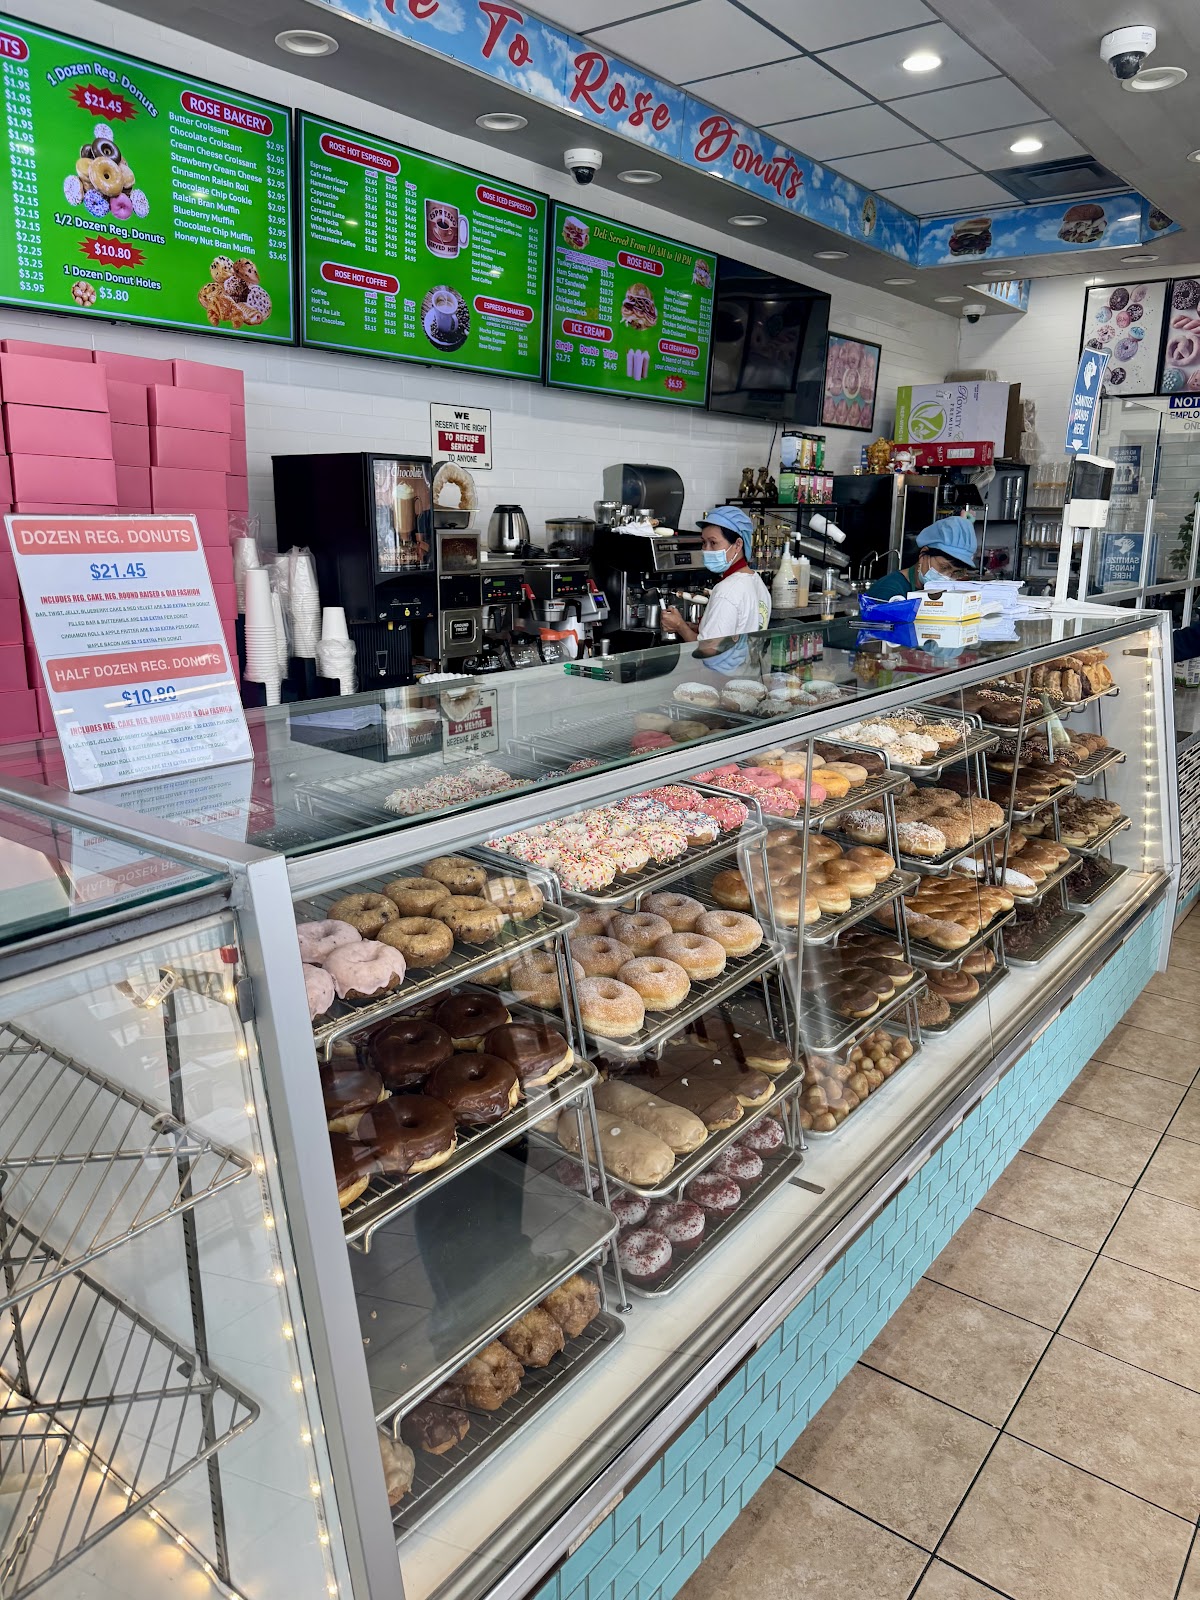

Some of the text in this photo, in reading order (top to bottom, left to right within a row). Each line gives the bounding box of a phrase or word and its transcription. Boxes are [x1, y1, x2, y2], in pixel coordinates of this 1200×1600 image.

[0, 37, 21, 56] TS
[3, 62, 28, 78] $1.95
[4, 75, 30, 91] $1.95
[47, 63, 158, 118] 1 Dozen Reg. Donuts
[5, 88, 31, 104] $1.95
[84, 91, 122, 113] $21.45
[479, 1, 804, 199] To Rose Donuts
[6, 102, 32, 117] $1.95
[190, 97, 266, 131] ROSE BAKERY
[7, 115, 33, 130] $1.95
[8, 128, 34, 143] $1.95
[169, 112, 284, 152] Butter Croissant $2.95
[9, 141, 35, 156] $1.95
[170, 126, 284, 164] Chocolate Croissant $2.95
[10, 154, 36, 169] $2.15
[170, 139, 284, 176] Cream Cheese Croissant $2.95
[329, 141, 391, 168] ROSE HOT ESPRESSO
[11, 167, 37, 181] $2.15
[171, 152, 285, 189] Strawberry Cream Cheese $2.95
[12, 180, 38, 194] $2.15
[172, 166, 285, 201] Cinnamon Raisin Roll $2.95
[13, 193, 38, 206] $2.15
[172, 179, 285, 213] Chocolate Chip Cookie $2.95
[483, 191, 532, 212] ROSE ICED ESPRESSO
[14, 206, 39, 219] $2.15
[173, 192, 286, 225] Raisin Bran Muffin $2.95
[15, 218, 40, 232] $2.15
[55, 214, 165, 244] 1/2 Dozen Reg. Donuts
[173, 205, 286, 237] Blueberry Muffin $2.95
[16, 231, 41, 244] $2.25
[174, 218, 286, 249] Chocolate Chip Muffin $2.95
[17, 244, 42, 256] $2.25
[94, 242, 131, 259] $10.80
[175, 231, 286, 261] Honey Nut Bran Muffin $3.45
[594, 226, 692, 265] Deli Served From 10 AM to 10 PM
[18, 256, 43, 268] $3.25
[627, 256, 641, 267] ROSE
[643, 260, 656, 272] DELI
[19, 268, 44, 280] $3.25
[64, 265, 161, 289] 1 Dozen Donut Holes
[335, 270, 387, 287] ROSE HOT COFFEE
[20, 281, 44, 292] $3.95
[100, 286, 128, 301] $3.80
[484, 302, 524, 316] ESPRESSO SHAKES
[572, 323, 605, 338] ICE CREAM
[556, 340, 618, 360] Single Double Triple
[670, 344, 681, 352] CREAM
[682, 346, 696, 355] SHAKES
[556, 353, 617, 370] $2.75 $3.75 $4.45
[668, 378, 682, 388] $6.55
[956, 386, 968, 428] ROYALTY
[1075, 395, 1093, 408] SANITIZE
[454, 412, 469, 420] WE
[1074, 409, 1089, 422] HANDS
[435, 421, 459, 430] RESERVE
[472, 424, 487, 432] RIGHT
[1073, 423, 1085, 435] HERE
[445, 433, 479, 443] TO REFUSE
[451, 443, 474, 451] SERVICE
[457, 455, 477, 463] ANYONE
[20, 530, 191, 545] DOZEN REG. DONUTS
[90, 562, 146, 580] $21.45
[40, 595, 71, 604] INCLUDES
[55, 654, 221, 682] HALF DOZEN REG. DONUTS
[122, 685, 177, 706] $10.80
